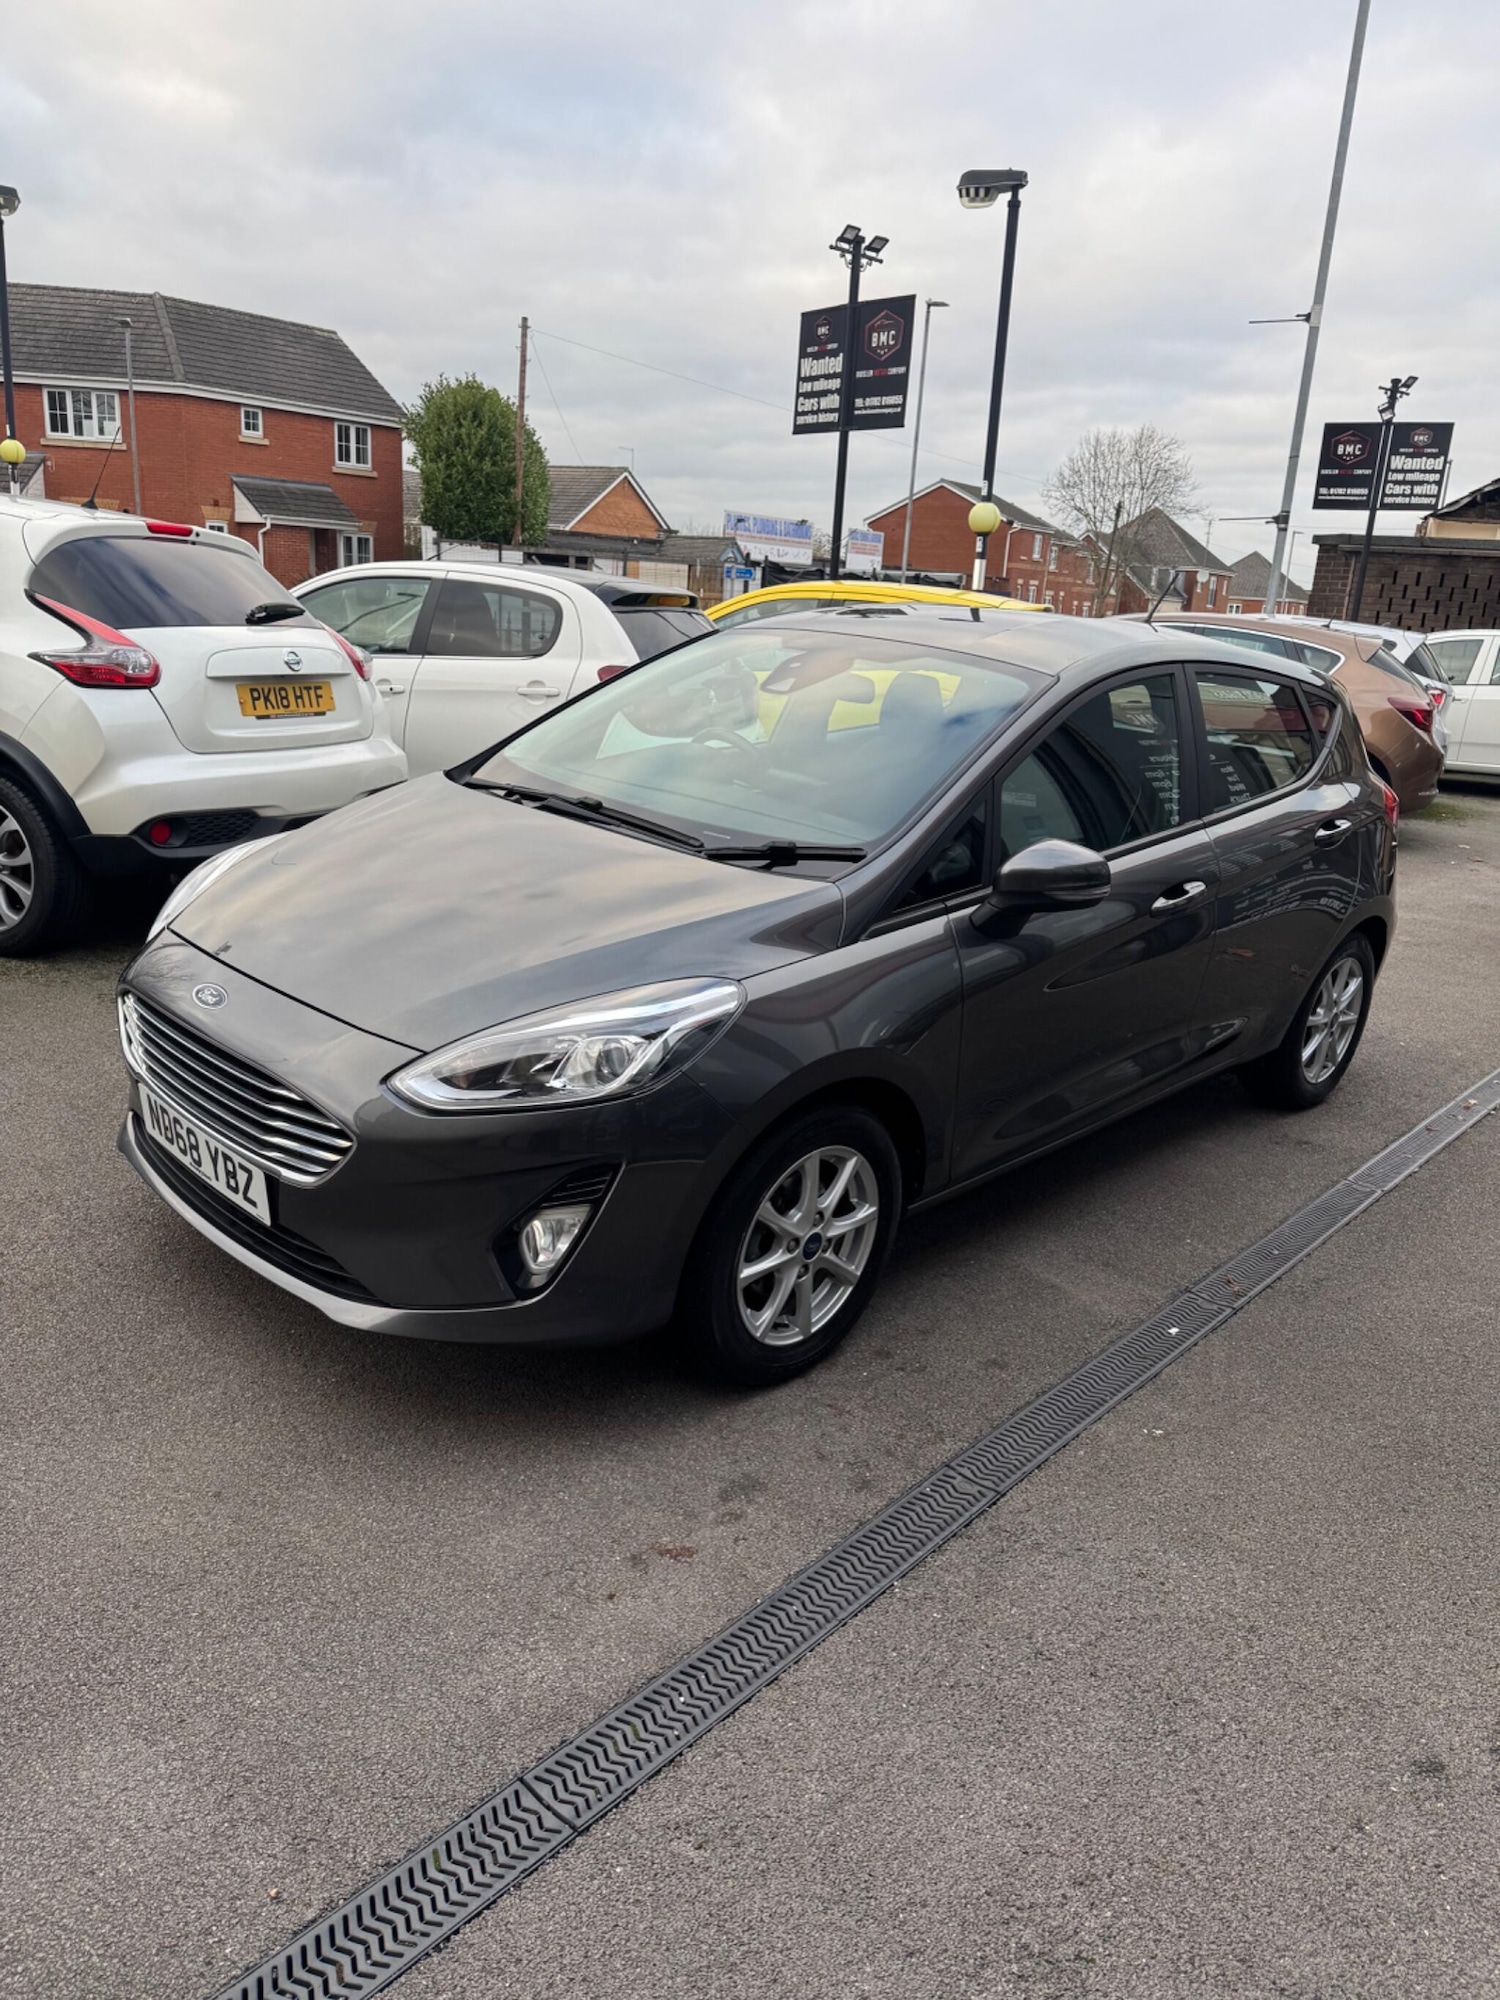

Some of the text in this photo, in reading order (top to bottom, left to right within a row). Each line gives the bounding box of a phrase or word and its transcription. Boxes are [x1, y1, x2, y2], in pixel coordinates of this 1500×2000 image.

[817, 325, 830, 336] BMC
[871, 330, 896, 347] BMC
[800, 353, 844, 378] Wanted
[799, 377, 841, 393] Low mileage
[797, 394, 840, 412] Cars with
[796, 411, 839, 425] service history
[1336, 444, 1363, 455] BMC
[1390, 455, 1444, 470] Wanted
[1388, 472, 1440, 483] Low mileage
[1385, 483, 1439, 495] Cars with
[1383, 496, 1436, 505] service history
[249, 685, 323, 711] PK18 HTF
